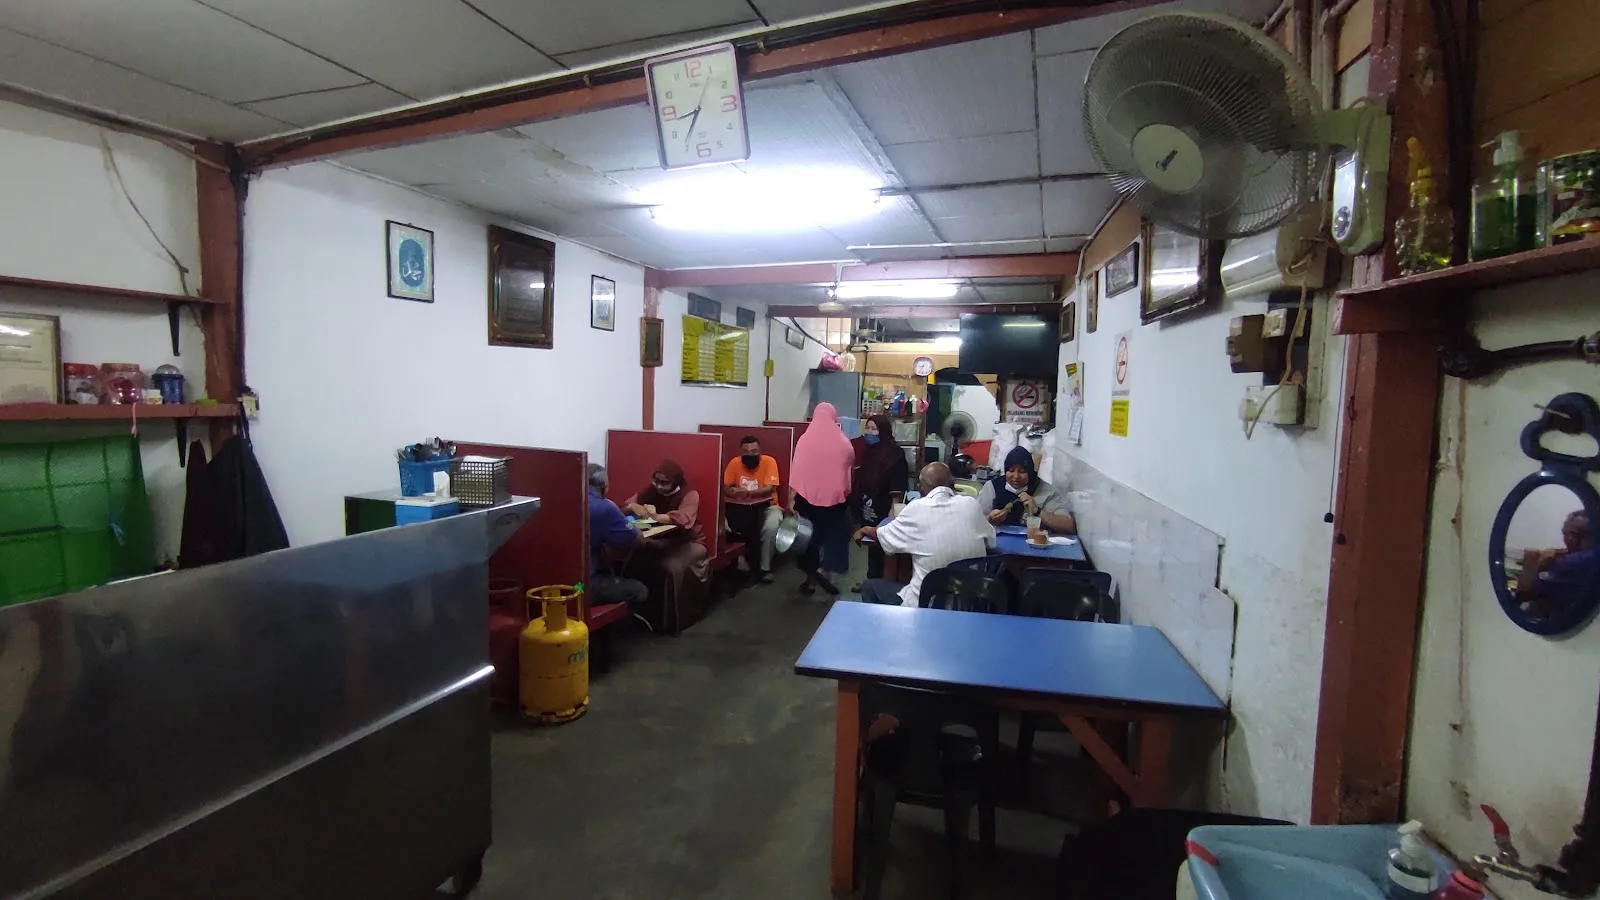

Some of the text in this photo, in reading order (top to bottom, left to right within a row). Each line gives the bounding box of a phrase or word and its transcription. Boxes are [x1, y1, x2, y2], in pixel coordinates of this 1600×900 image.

[684, 59, 702, 79] 12
[674, 72, 680, 81] 11
[721, 81, 728, 89] 2
[665, 91, 673, 99] 10
[720, 95, 738, 113] 3
[661, 105, 678, 122] 9
[726, 122, 733, 130] 4
[672, 131, 678, 139] 8
[696, 142, 711, 158] 6
